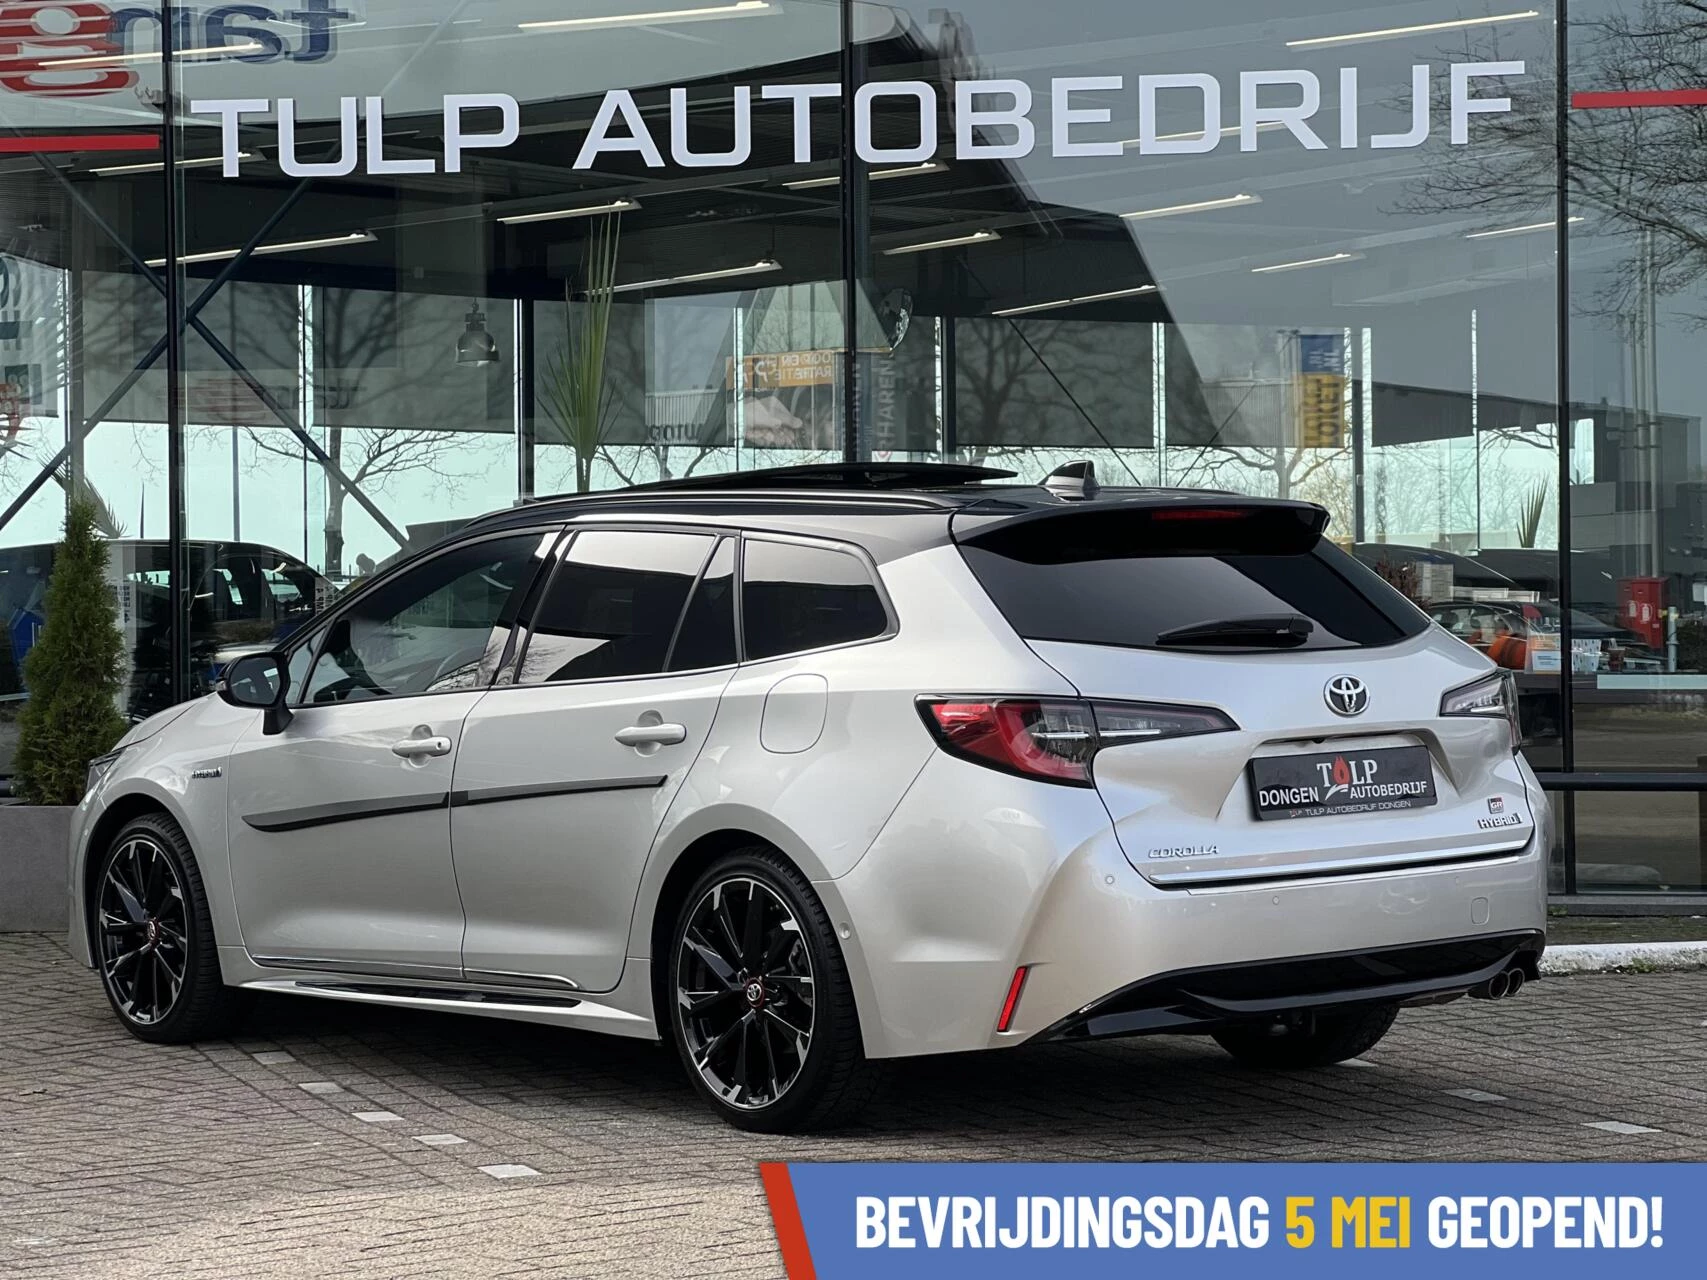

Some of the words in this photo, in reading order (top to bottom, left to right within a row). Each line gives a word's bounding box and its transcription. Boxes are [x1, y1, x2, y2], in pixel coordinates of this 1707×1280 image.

[190, 93, 520, 178] TULP
[572, 60, 1525, 170] AUTOBEDRIJF
[1258, 786, 1320, 806] DONGEN
[1349, 780, 1428, 799] AUTOBEDRIJF
[1305, 808, 1325, 816] TULP
[1326, 802, 1377, 814] AUTOBEDRIJF
[1378, 800, 1411, 810] DONGEN
[1490, 801, 1503, 809] GR
[1477, 813, 1520, 829] HYBRID
[1148, 844, 1220, 859] COROLLA
